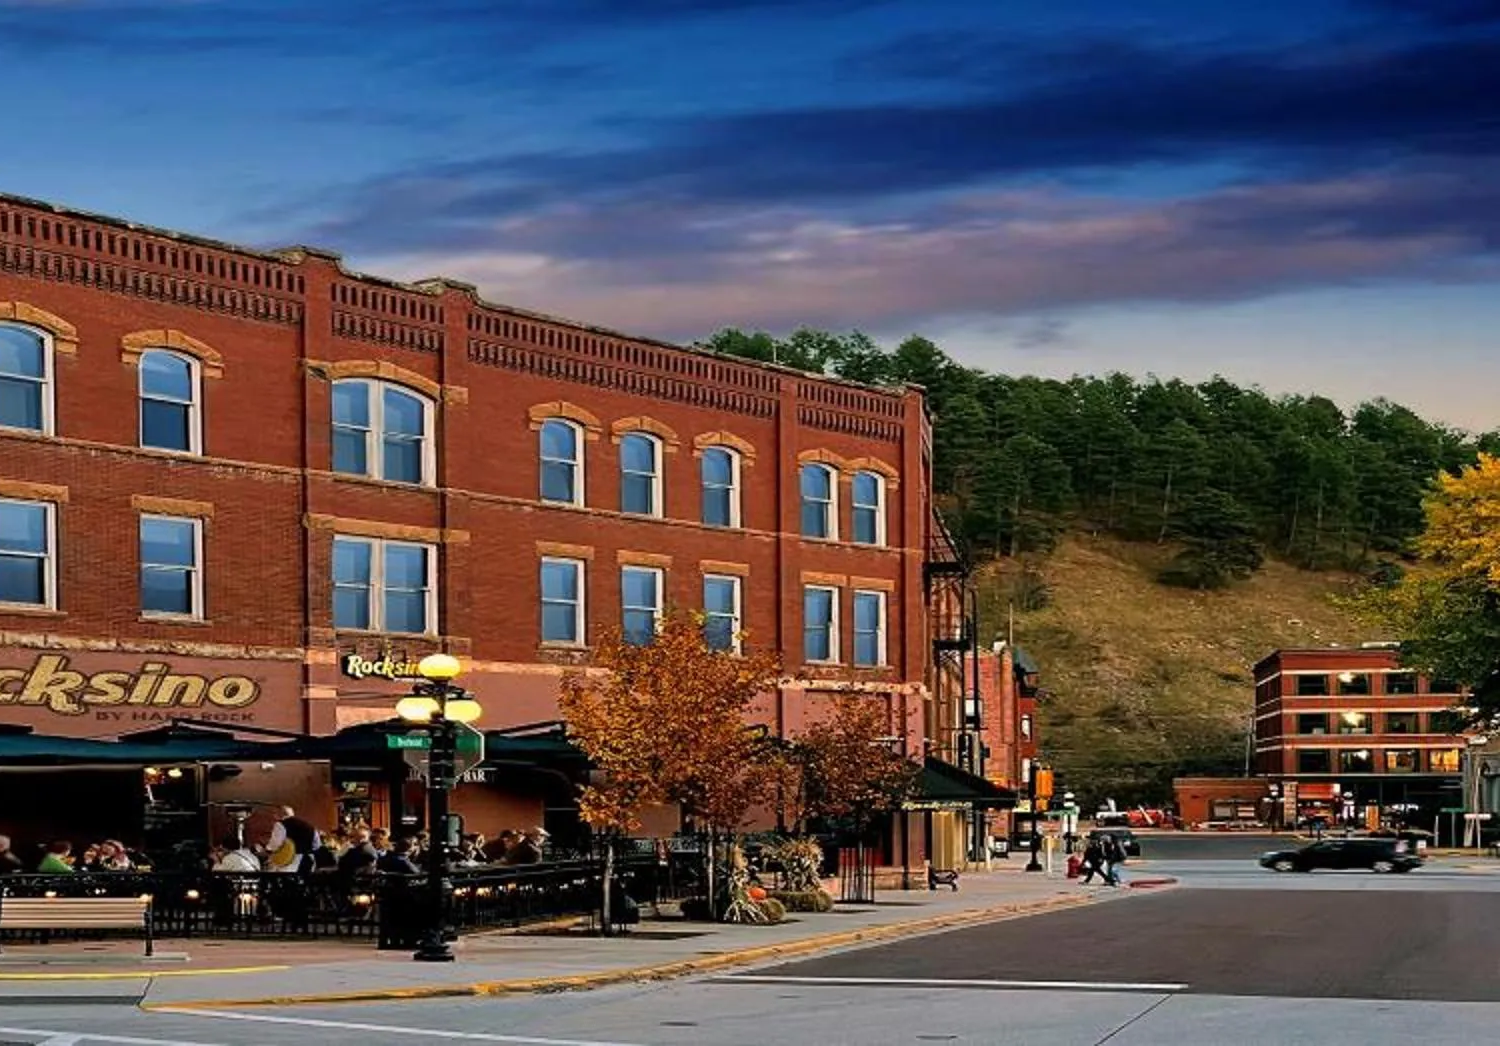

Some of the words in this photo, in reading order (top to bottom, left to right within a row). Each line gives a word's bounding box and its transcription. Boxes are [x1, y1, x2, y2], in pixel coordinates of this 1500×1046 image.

[346, 654, 422, 679] Rocksin
[95, 710, 124, 721] BY
[201, 711, 256, 722] ROCK
